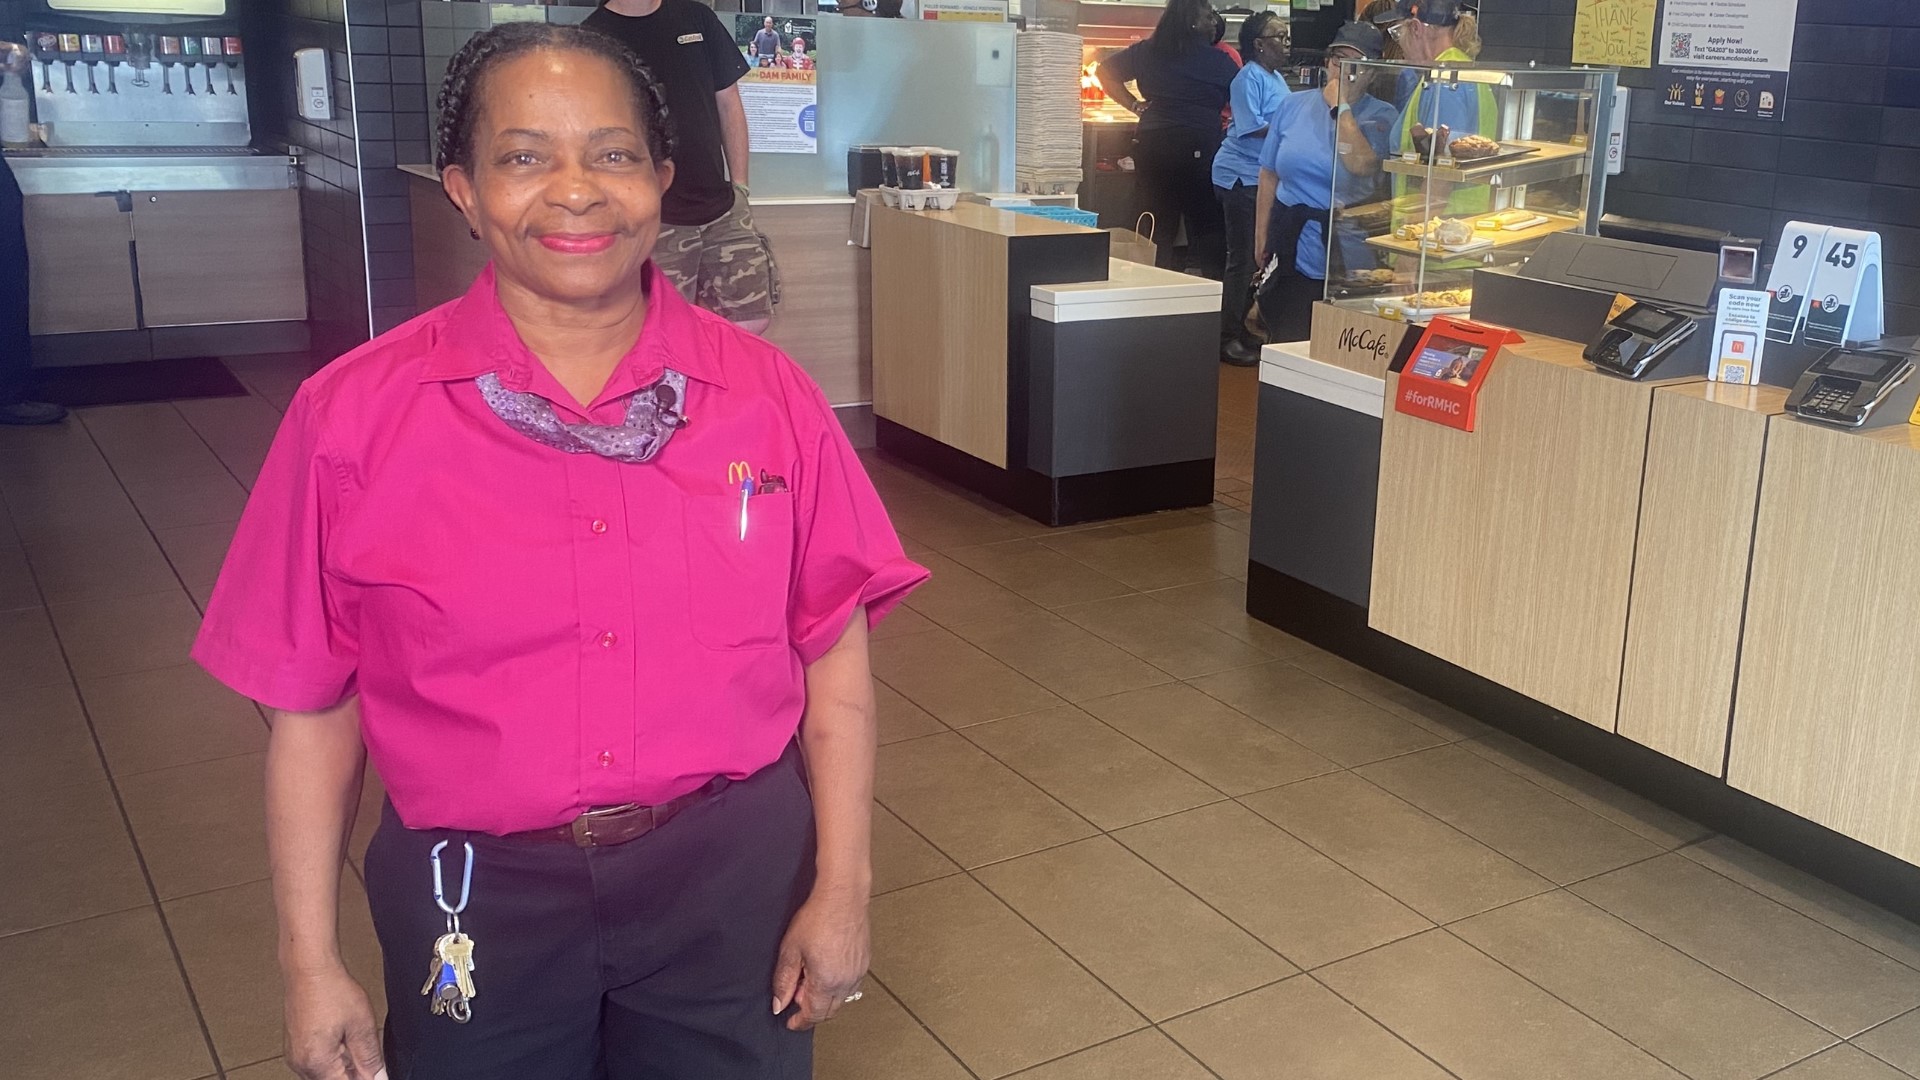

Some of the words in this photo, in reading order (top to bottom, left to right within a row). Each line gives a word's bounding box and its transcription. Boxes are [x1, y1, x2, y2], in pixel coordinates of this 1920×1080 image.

[1586, 1, 1638, 28] THANK
[1708, 36, 1726, 45] Apply
[759, 70, 779, 79] DAM
[781, 71, 812, 81] FAMILY
[1792, 235, 1808, 259] 9
[1825, 242, 1859, 269] 45
[1338, 327, 1387, 361] McCafé
[1404, 389, 1461, 416] #forRMHC
